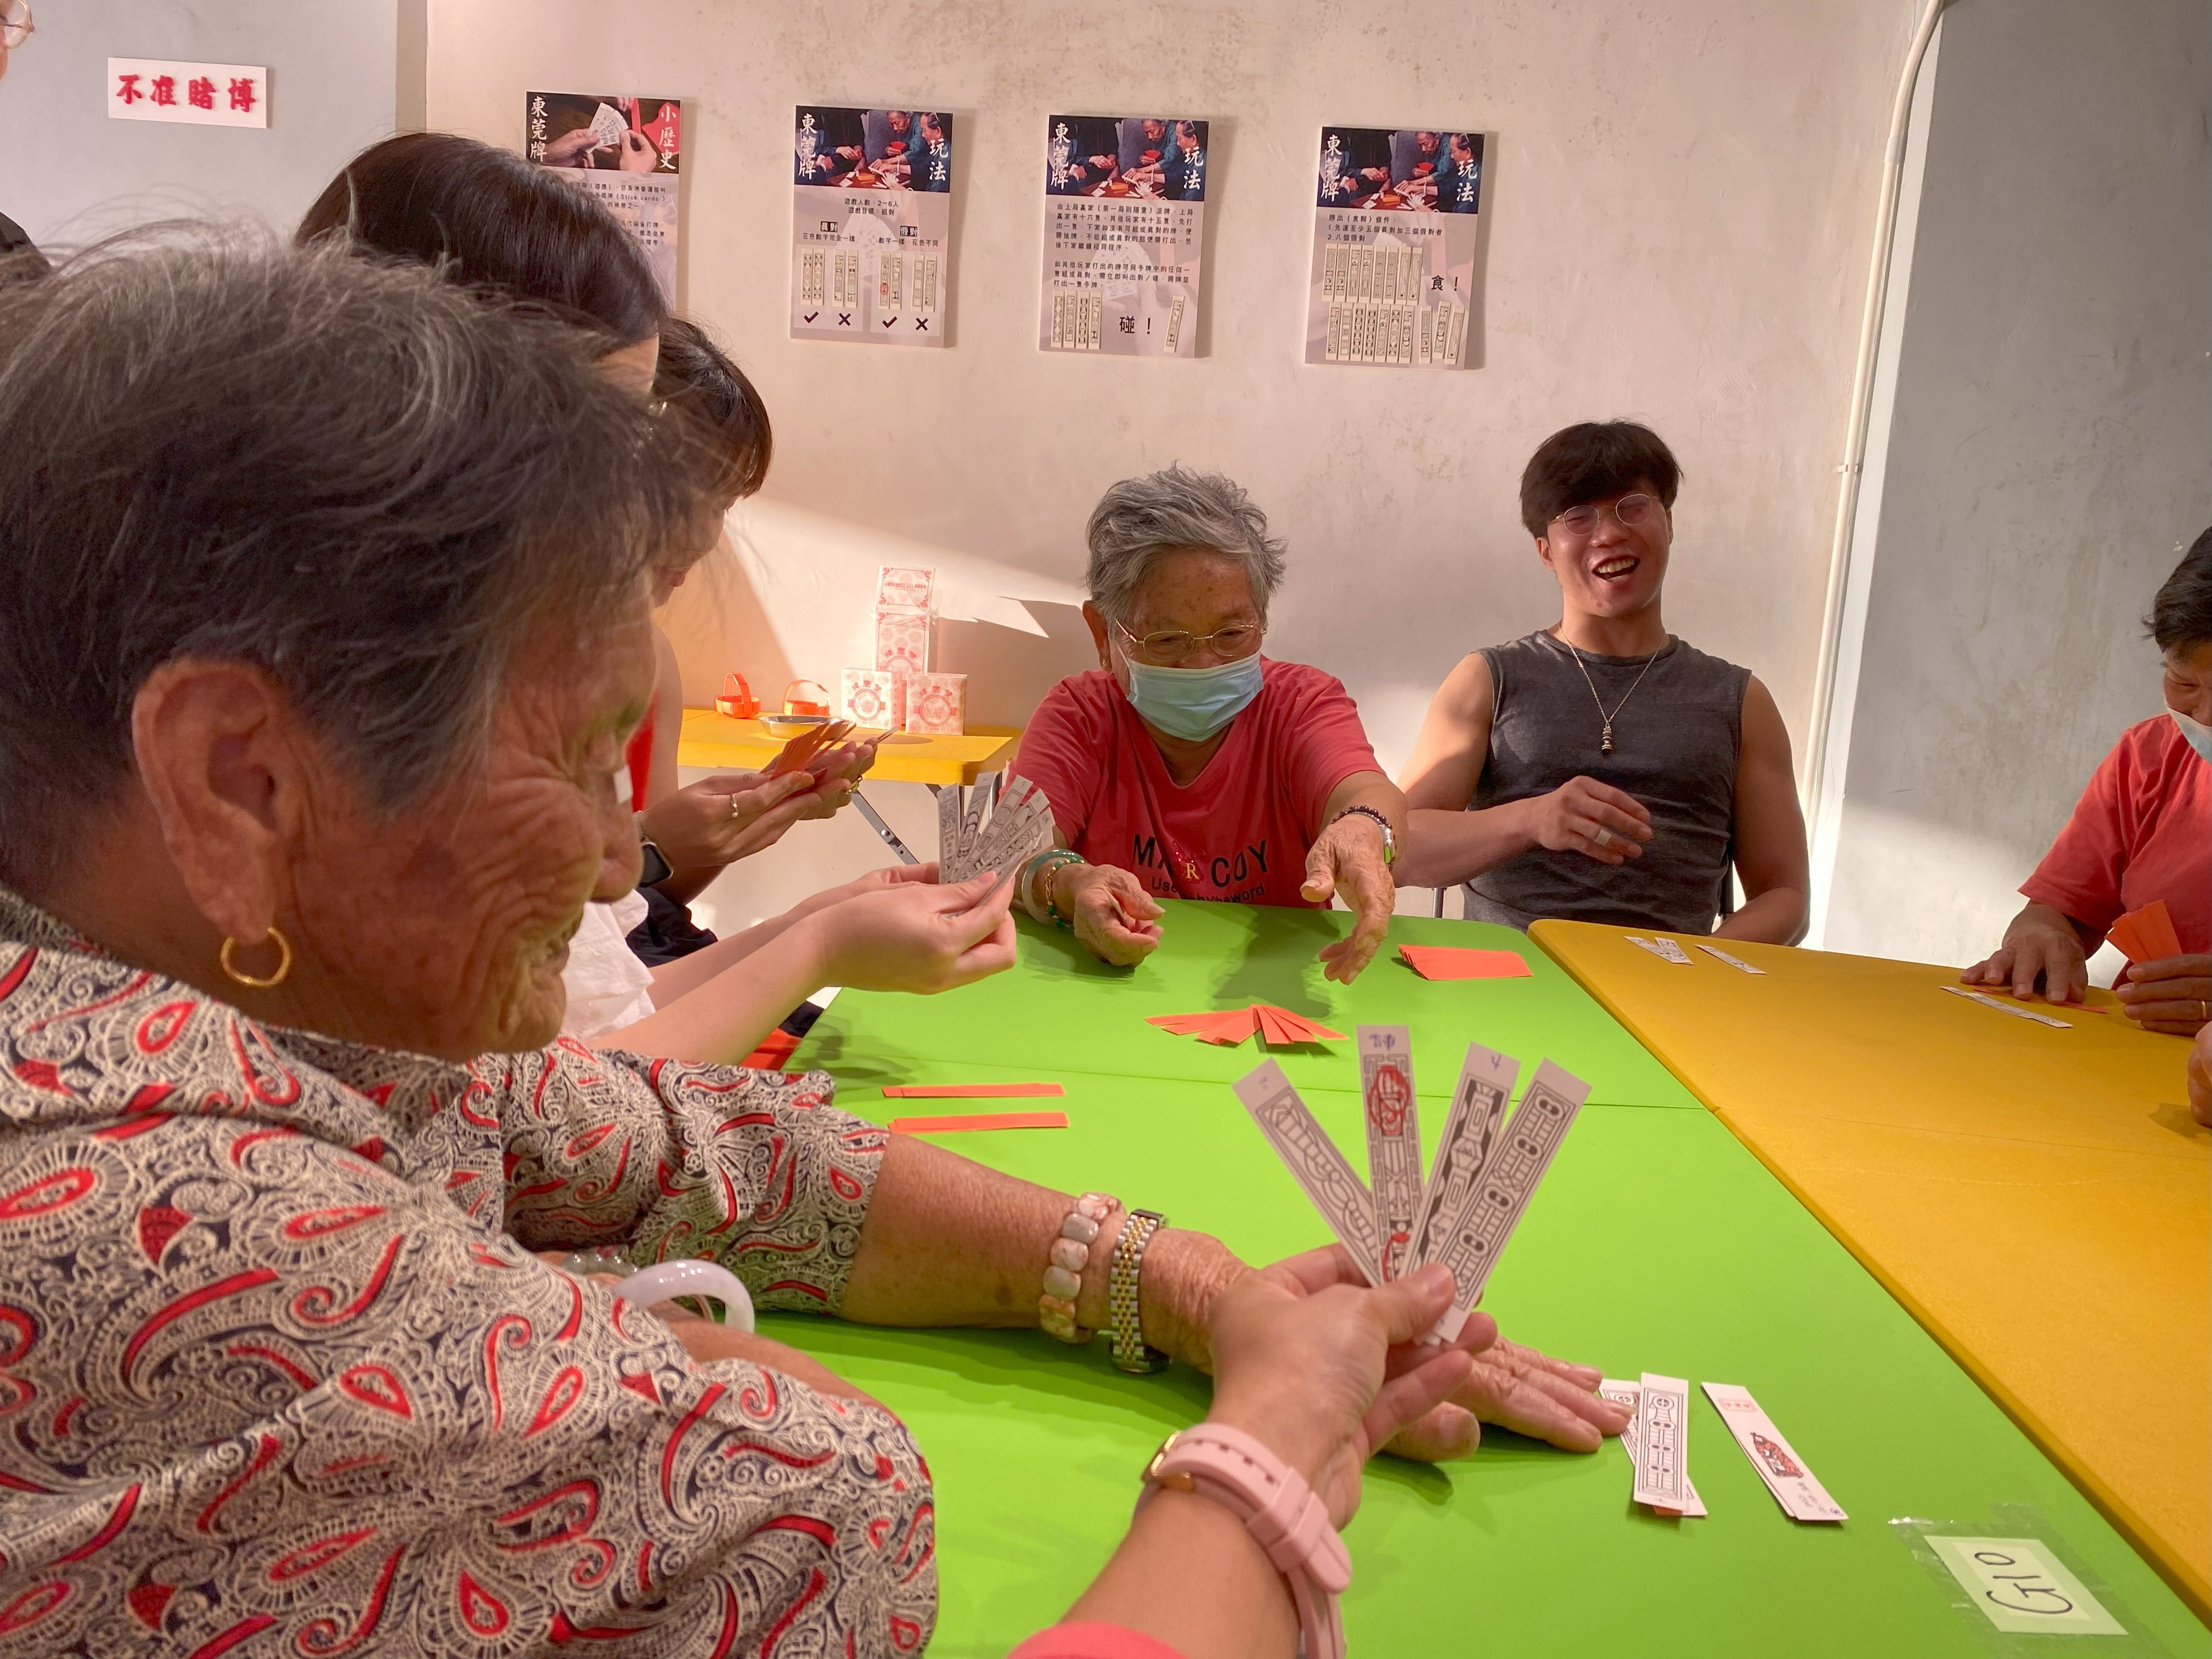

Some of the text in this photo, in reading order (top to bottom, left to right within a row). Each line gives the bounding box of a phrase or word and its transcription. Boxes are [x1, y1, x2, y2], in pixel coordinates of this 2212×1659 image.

[116, 74, 256, 112] 不准賭博
[530, 96, 548, 162] 東莞牌
[658, 105, 676, 170] 小歷史
[798, 113, 817, 180] 東莞牌
[929, 138, 949, 181] 玩法
[1051, 122, 1070, 190] 東莞牌
[1183, 146, 1203, 190] 玩法
[1321, 134, 1342, 202] 東莞牌
[1457, 159, 1477, 202] 玩法
[1431, 275, 1458, 291] 食！
[1119, 316, 1150, 334] 碰！
